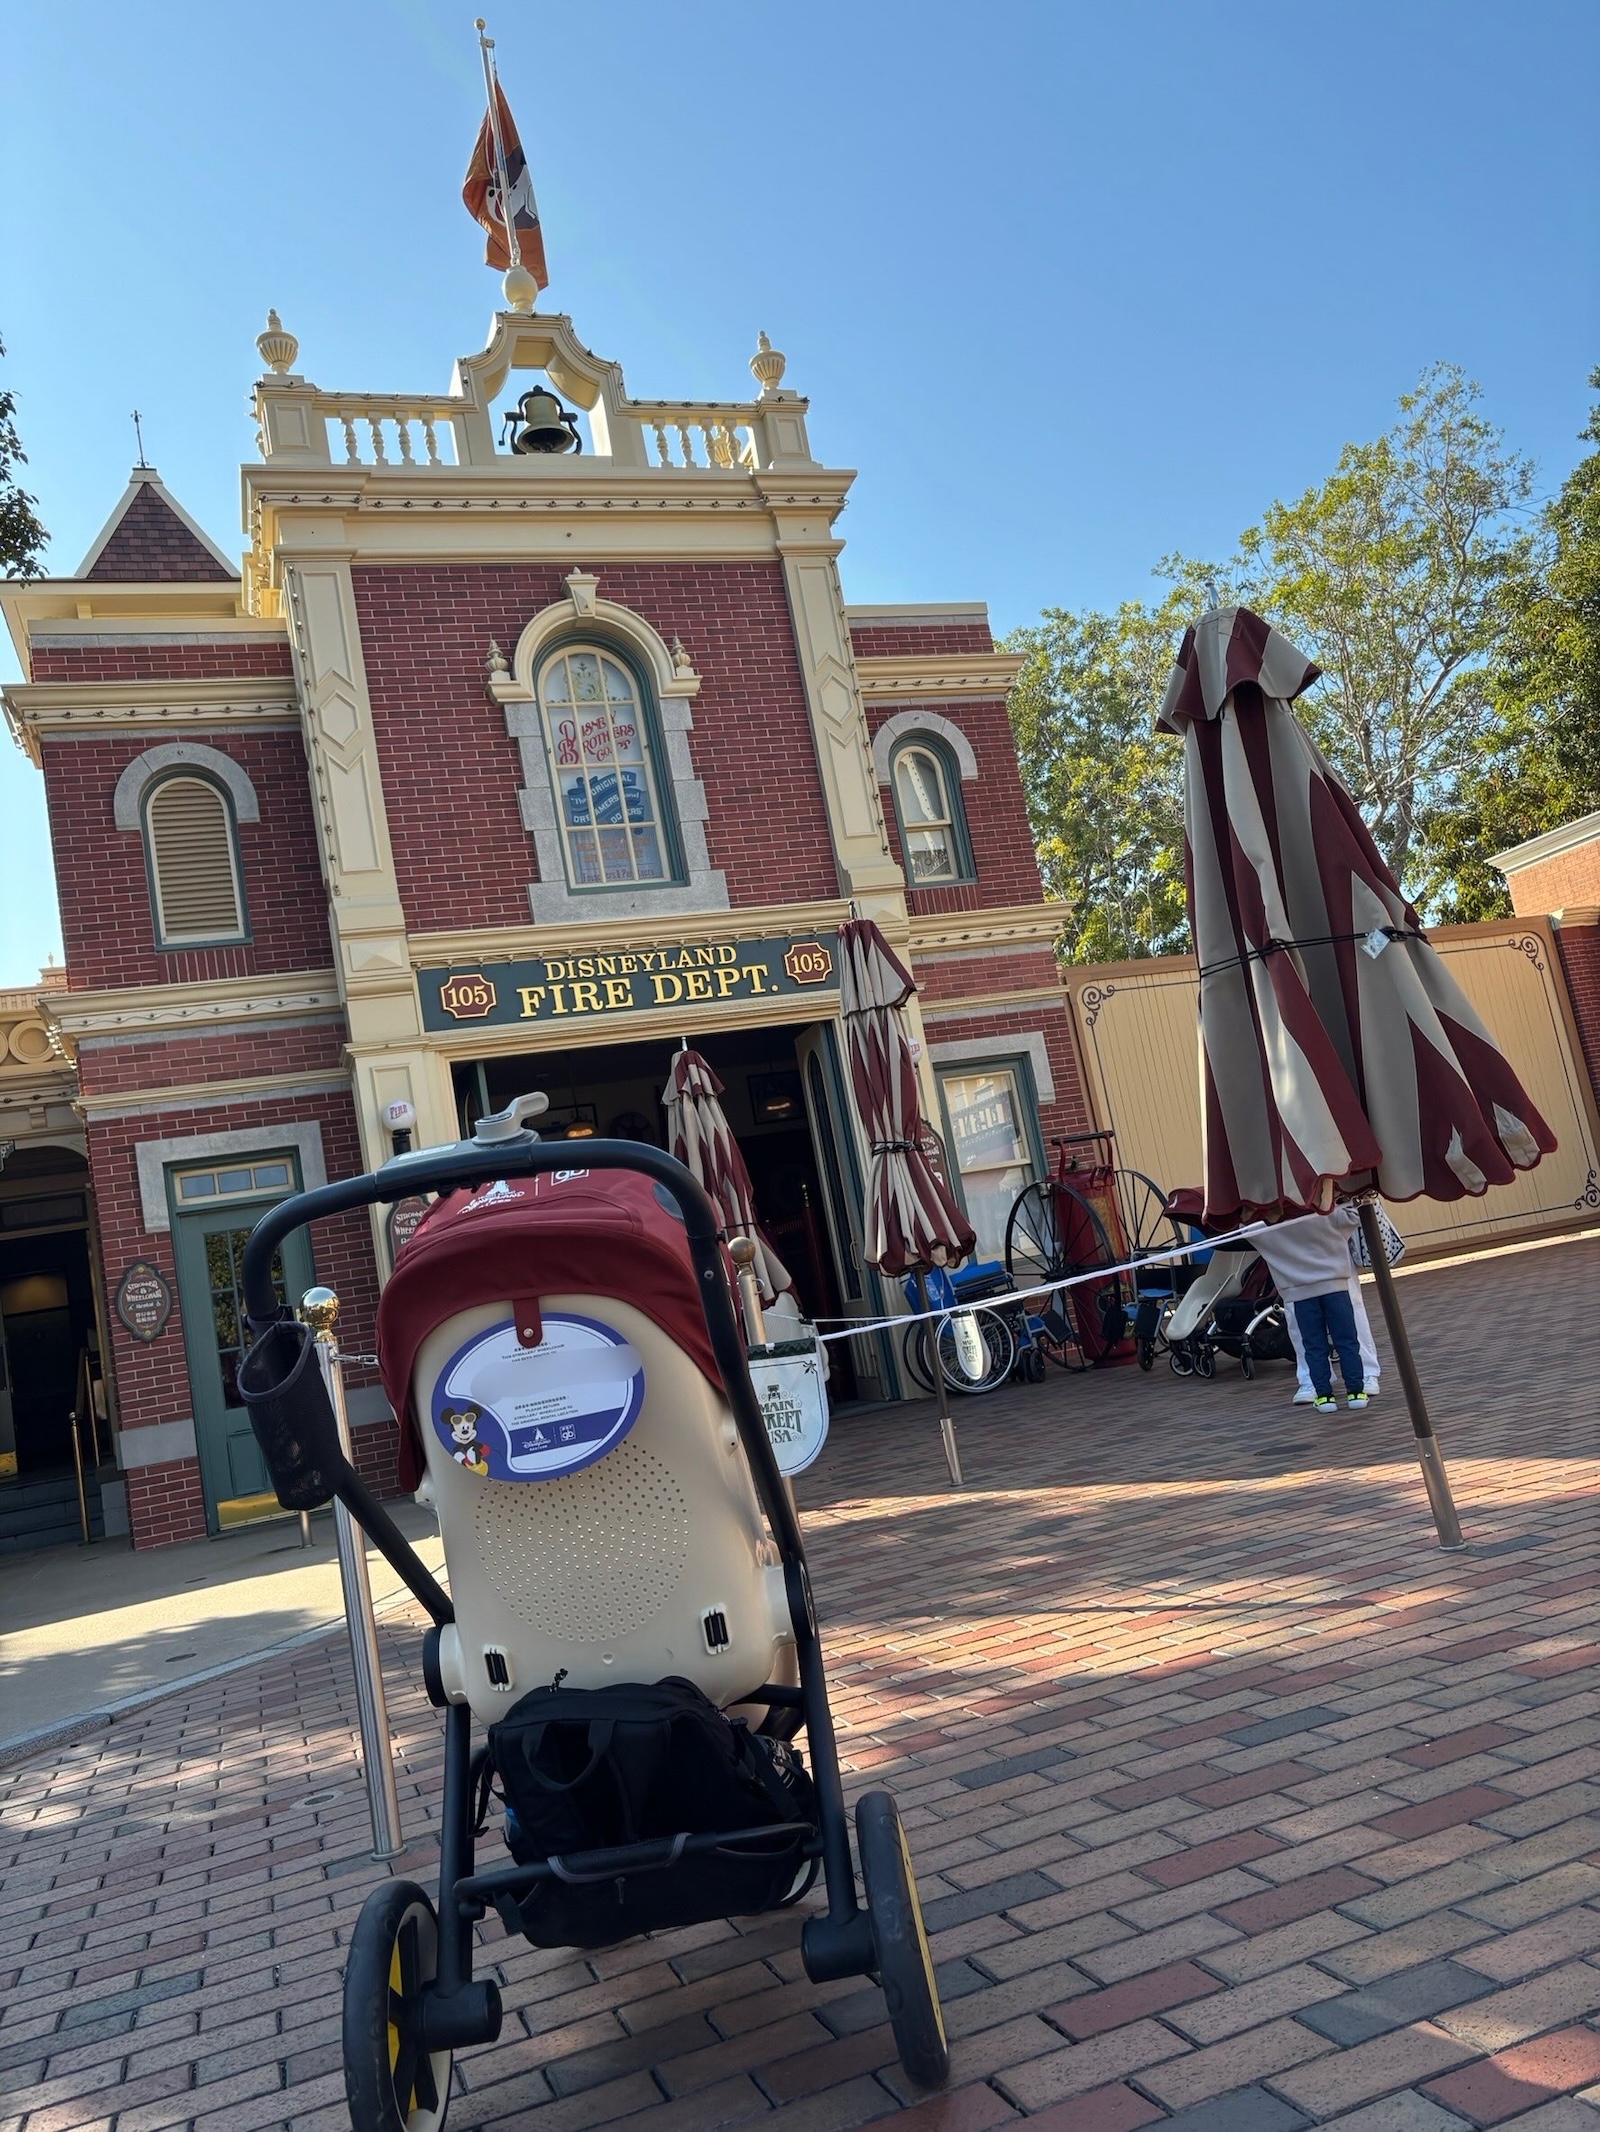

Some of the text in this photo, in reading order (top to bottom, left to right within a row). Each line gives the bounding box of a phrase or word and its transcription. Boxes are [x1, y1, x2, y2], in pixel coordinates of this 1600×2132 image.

[559, 711, 616, 743] DISNEY
[558, 724, 635, 764] BROTHERS
[591, 775, 633, 796] ORIGINAL
[573, 794, 619, 823] DREAMERS
[544, 946, 738, 981] DISNEYLAND
[790, 952, 825, 975] 105
[447, 984, 489, 1009] 105
[516, 964, 779, 1018] FIRE DEPT.
[390, 1104, 408, 1120] FIRE
[410, 1218, 417, 1226] &
[126, 1289, 162, 1302] WHEELCHAIR
[759, 1400, 794, 1412] MAIN
[562, 1430, 575, 1442] gb
